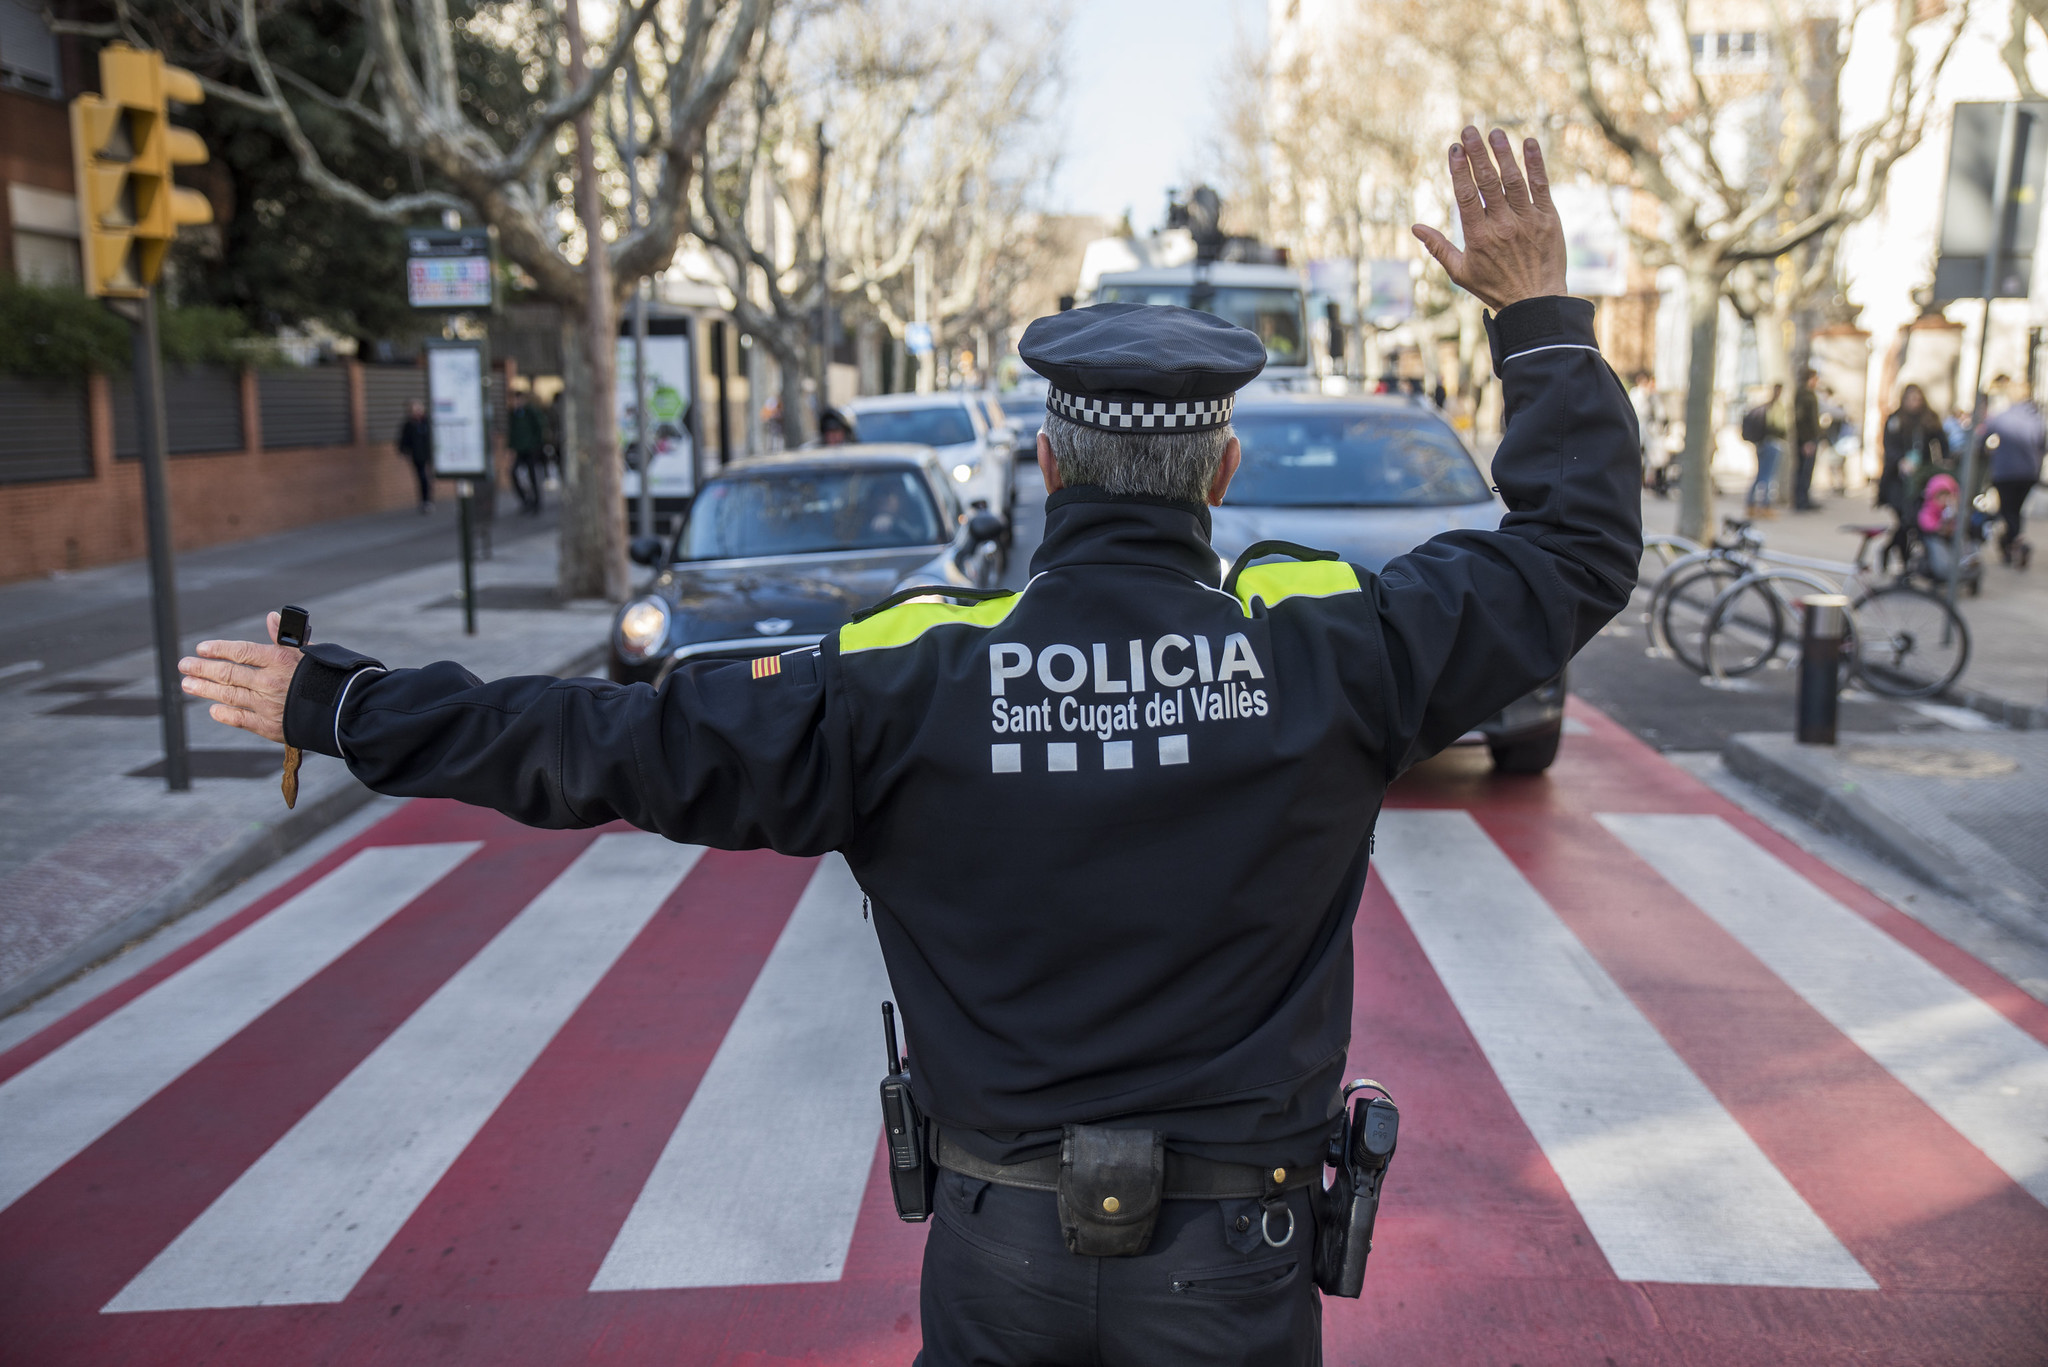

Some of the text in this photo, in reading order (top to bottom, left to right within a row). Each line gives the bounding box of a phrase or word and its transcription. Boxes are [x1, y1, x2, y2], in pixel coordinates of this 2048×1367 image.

[989, 631, 1265, 697] POLICIA
[991, 681, 1269, 741] Sant Cugat del Vallès
